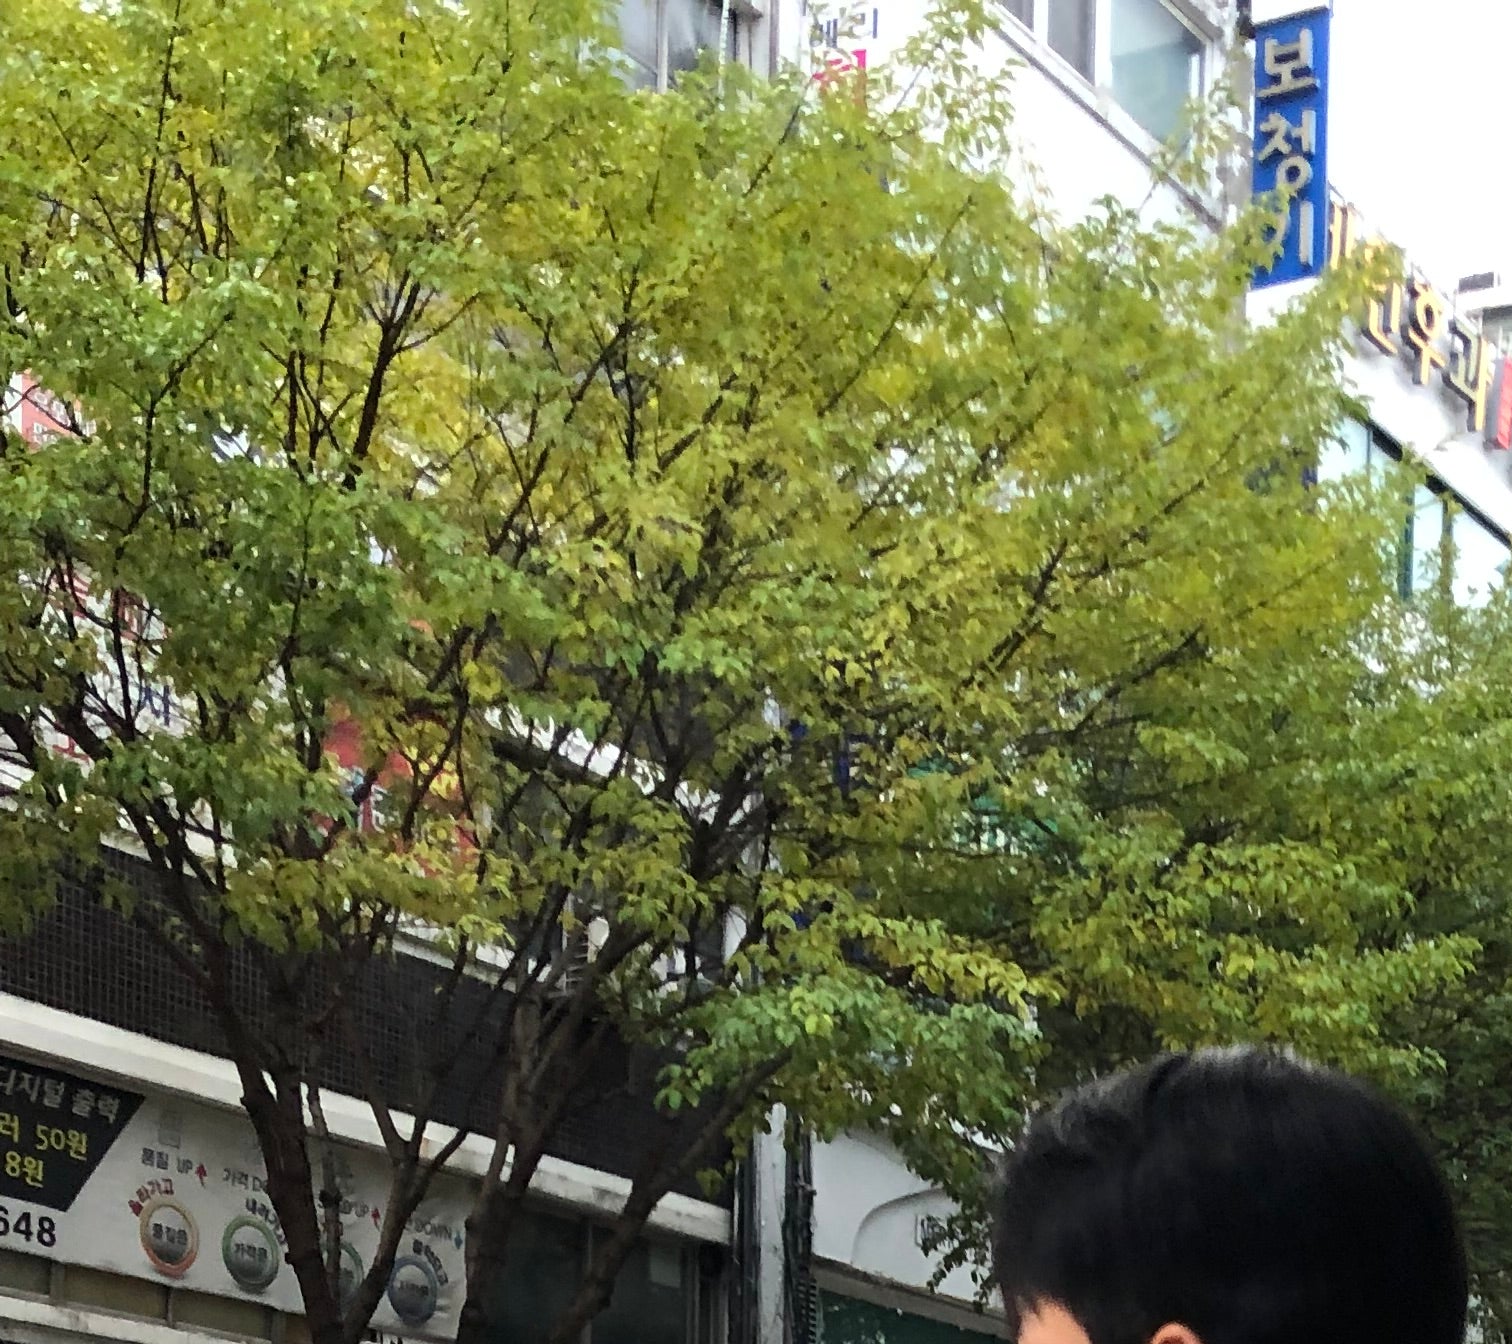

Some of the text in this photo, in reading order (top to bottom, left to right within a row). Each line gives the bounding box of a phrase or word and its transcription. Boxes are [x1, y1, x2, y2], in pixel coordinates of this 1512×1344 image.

[71, 1087, 122, 1125] 출력
[35, 1122, 88, 1161] 50원
[5, 1150, 44, 1188] 8원
